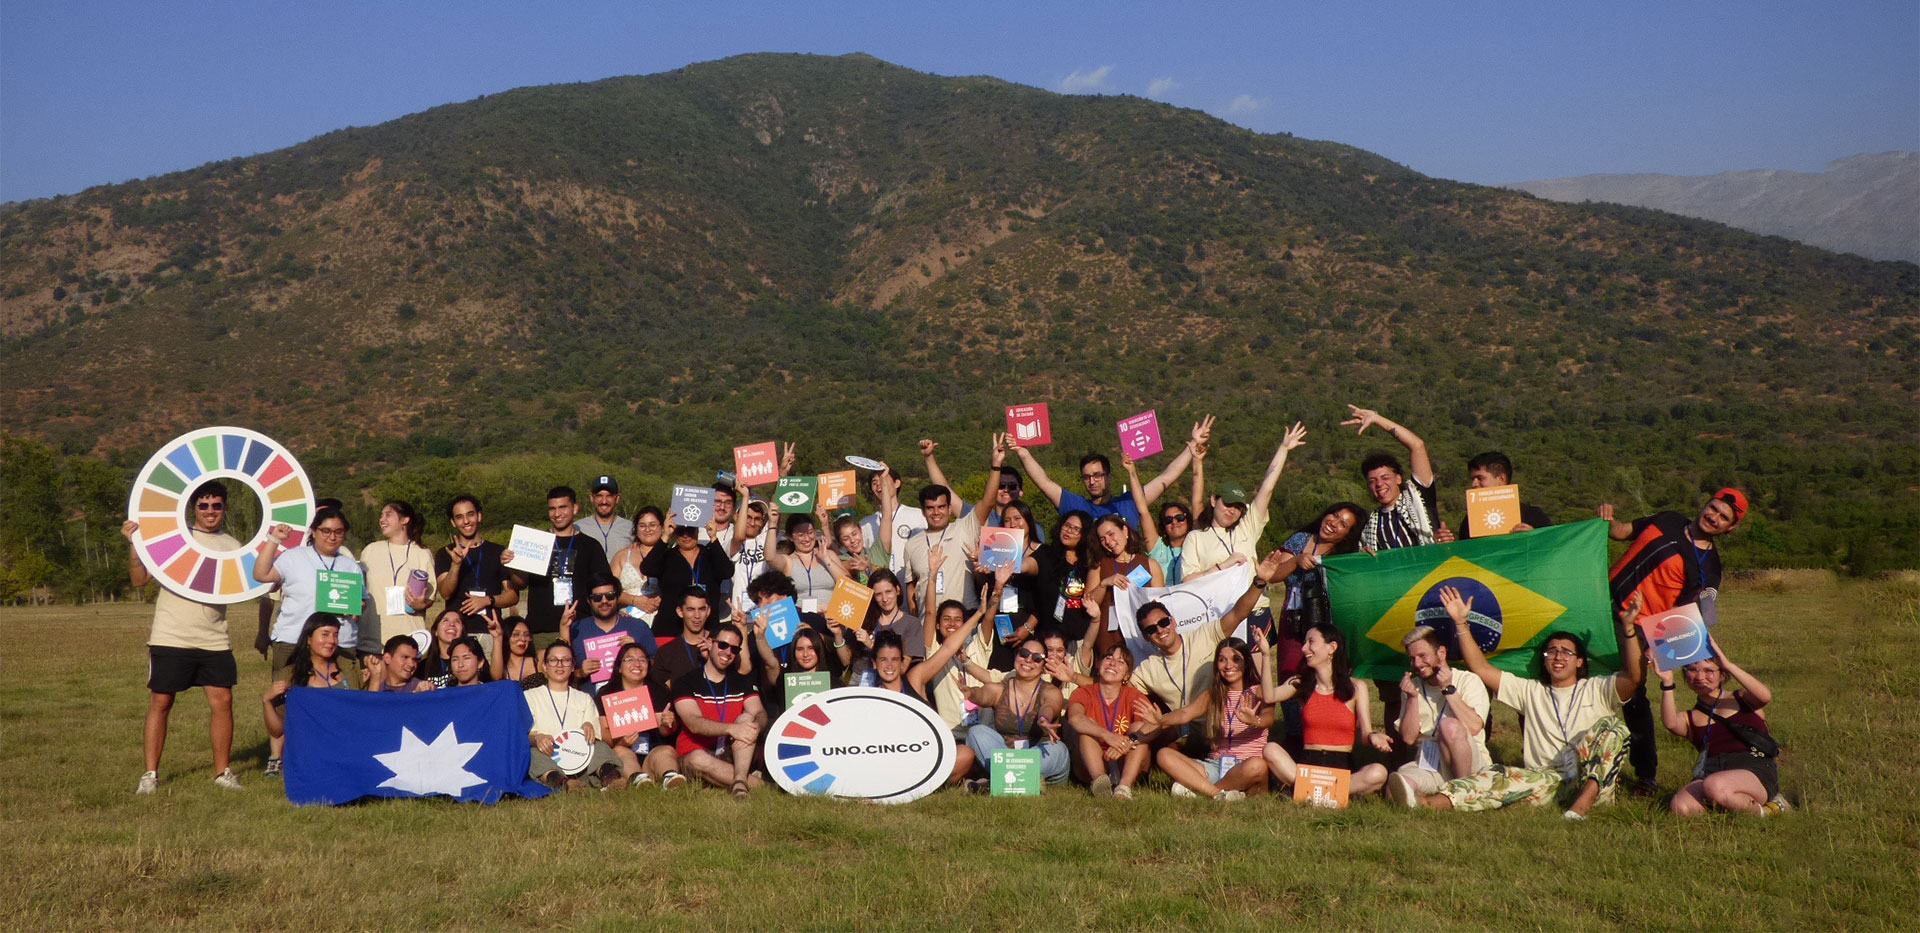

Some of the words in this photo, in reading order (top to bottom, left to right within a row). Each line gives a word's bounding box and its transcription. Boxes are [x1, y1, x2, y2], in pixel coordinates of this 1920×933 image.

[1009, 409, 1014, 418] 4
[1120, 422, 1128, 432] 10
[737, 450, 741, 459] 1
[779, 478, 787, 486] 13
[820, 476, 827, 484] 11
[676, 488, 684, 496] 17
[1470, 492, 1476, 503] 7
[514, 539, 549, 551] OBJETIVOS
[319, 572, 328, 582] 15
[838, 579, 844, 588] 7
[1468, 613, 1500, 629] GRESSO
[587, 641, 596, 651] 10
[787, 676, 796, 686] 13
[606, 698, 611, 707] 1
[822, 741, 930, 756] UNO.CINCO°
[993, 752, 1003, 763] 15
[1300, 768, 1308, 777] 11
